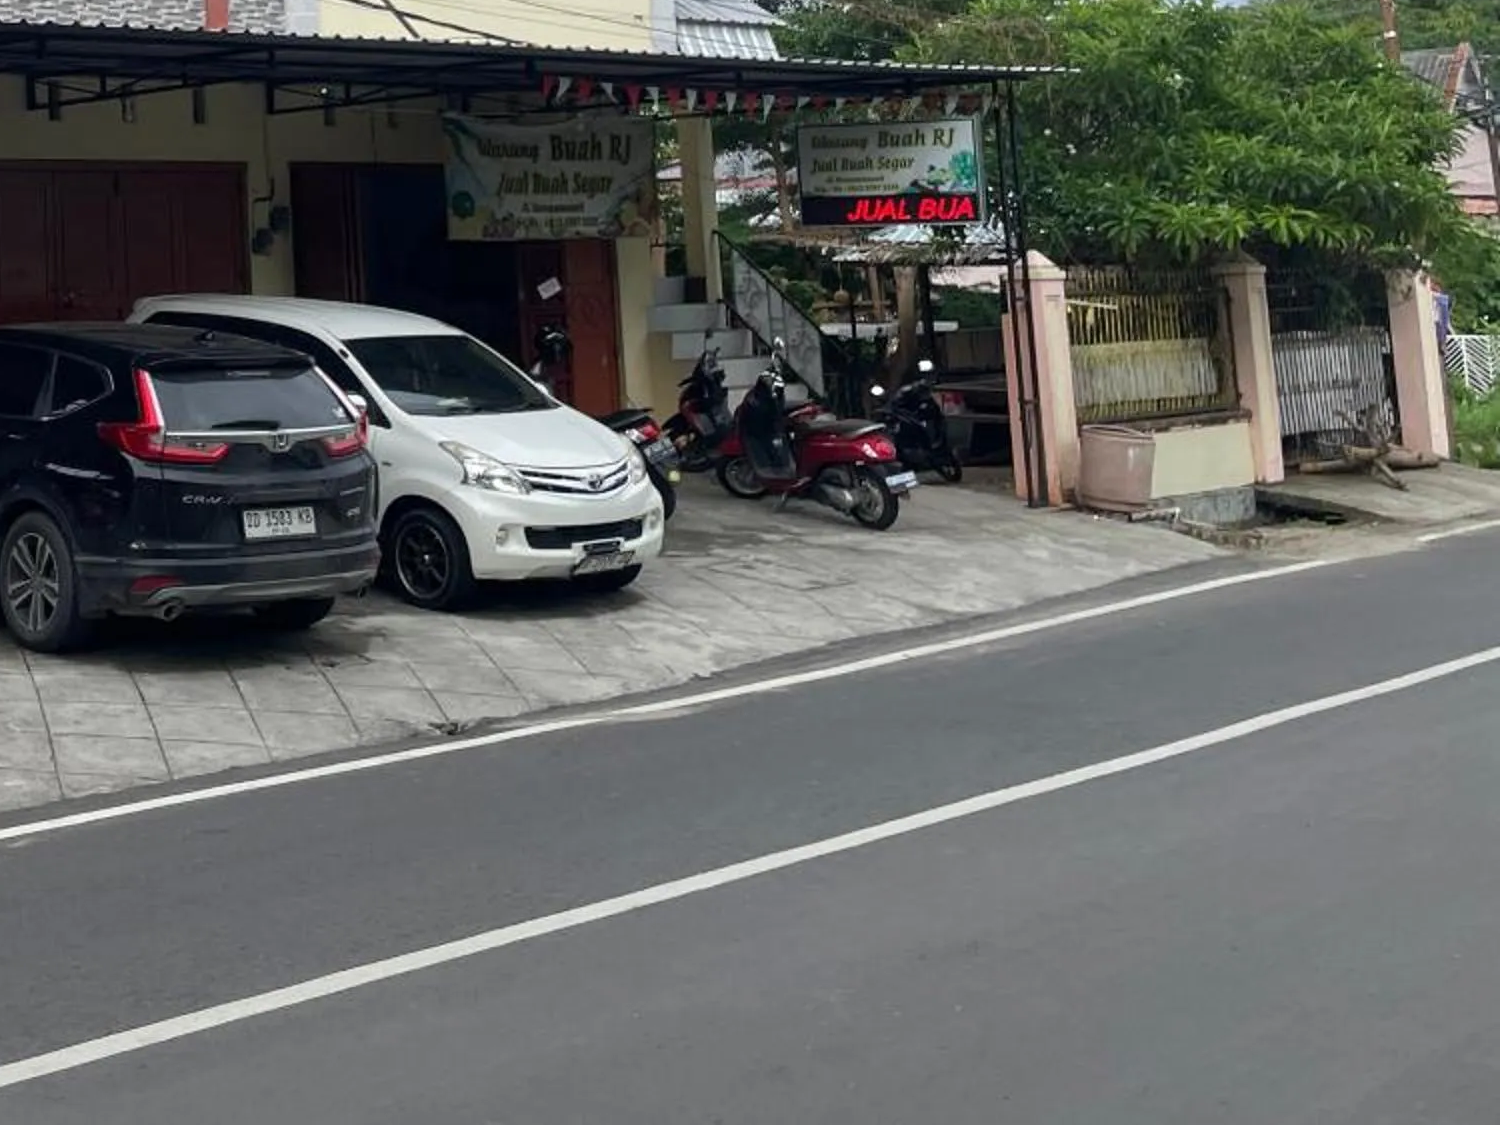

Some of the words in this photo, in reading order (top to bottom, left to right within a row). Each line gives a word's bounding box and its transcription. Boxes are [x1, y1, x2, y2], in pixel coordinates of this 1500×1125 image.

[549, 131, 602, 162] Buah
[609, 133, 632, 165] RJ
[878, 128, 926, 148] Buah
[932, 127, 955, 149] RJ
[811, 156, 838, 174] Jual
[841, 156, 873, 172] Buah
[877, 155, 915, 173] Segar
[496, 171, 529, 197] Jual
[533, 171, 569, 194] Buah
[572, 172, 613, 198] Segar
[846, 197, 911, 221] JUAL
[916, 196, 975, 220] BUA
